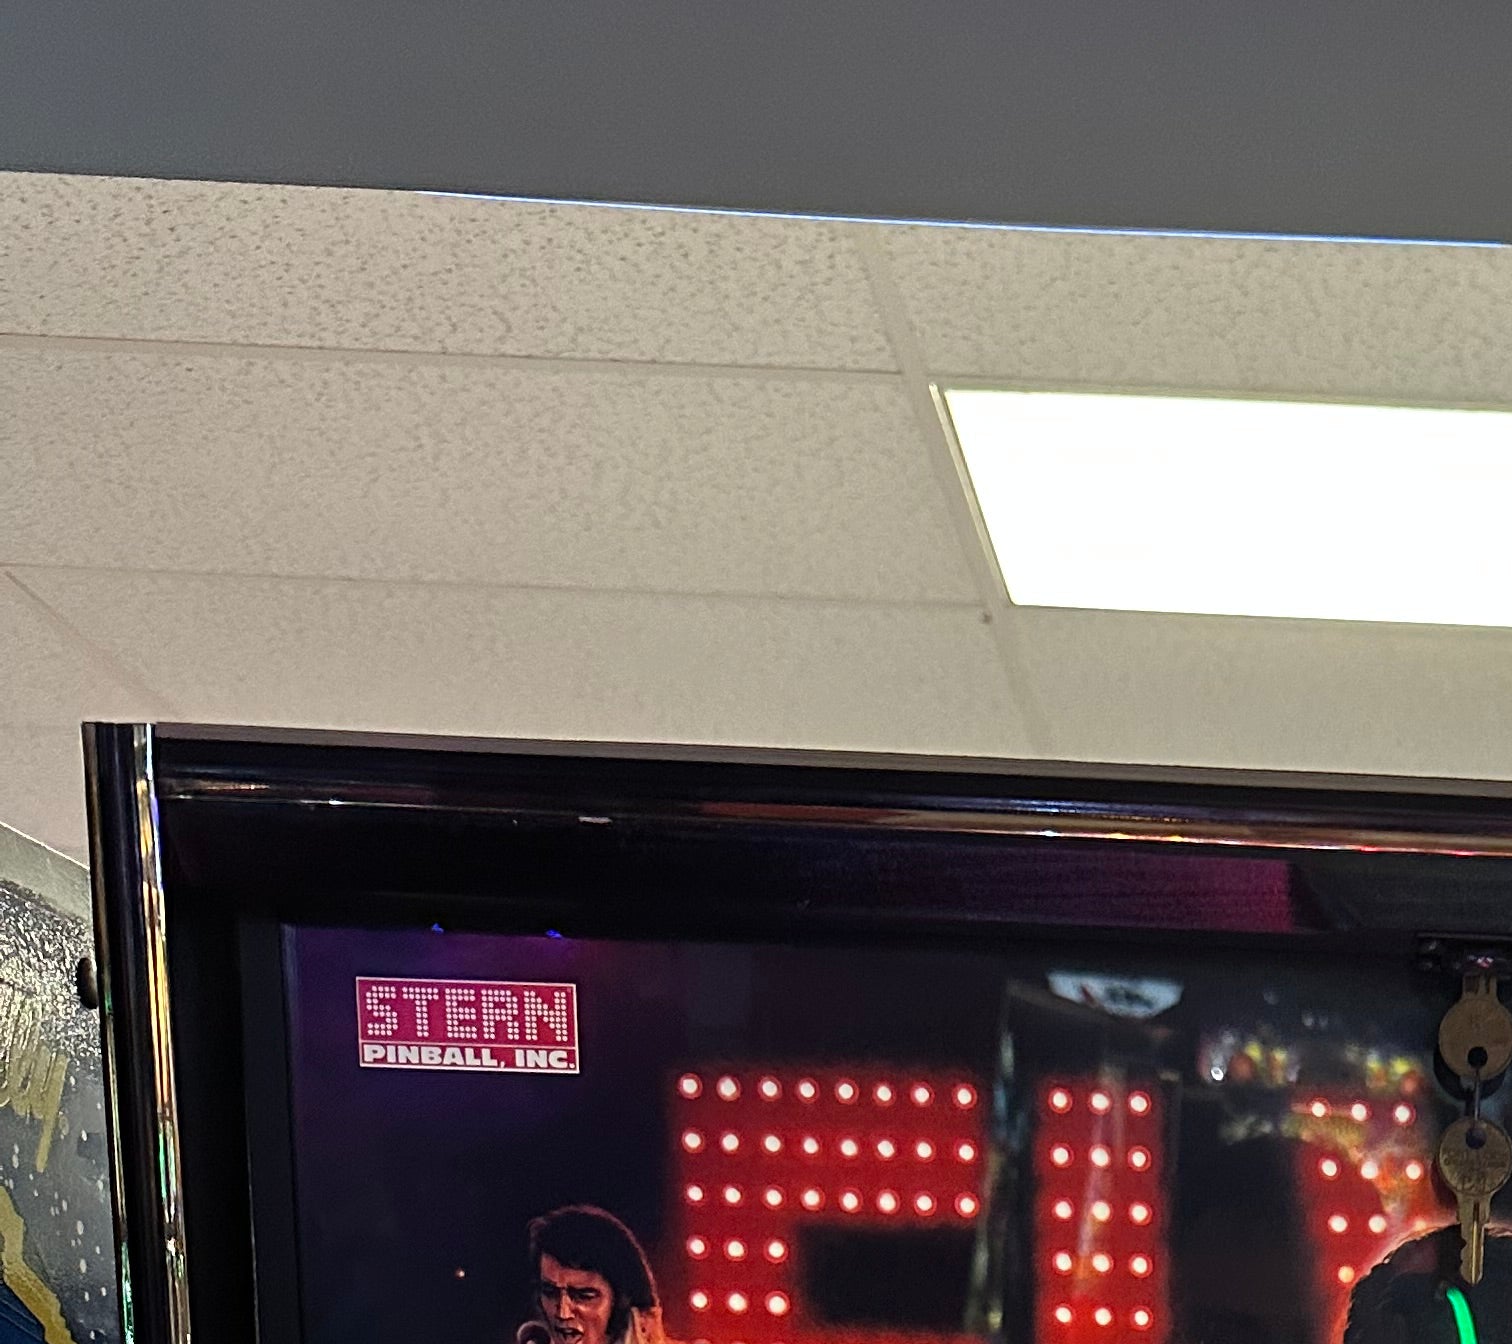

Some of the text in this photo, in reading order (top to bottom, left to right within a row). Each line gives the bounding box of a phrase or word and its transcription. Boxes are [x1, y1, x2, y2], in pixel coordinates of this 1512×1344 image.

[365, 985, 568, 1042] STERN
[362, 1043, 577, 1070] PINBALL, INC.
